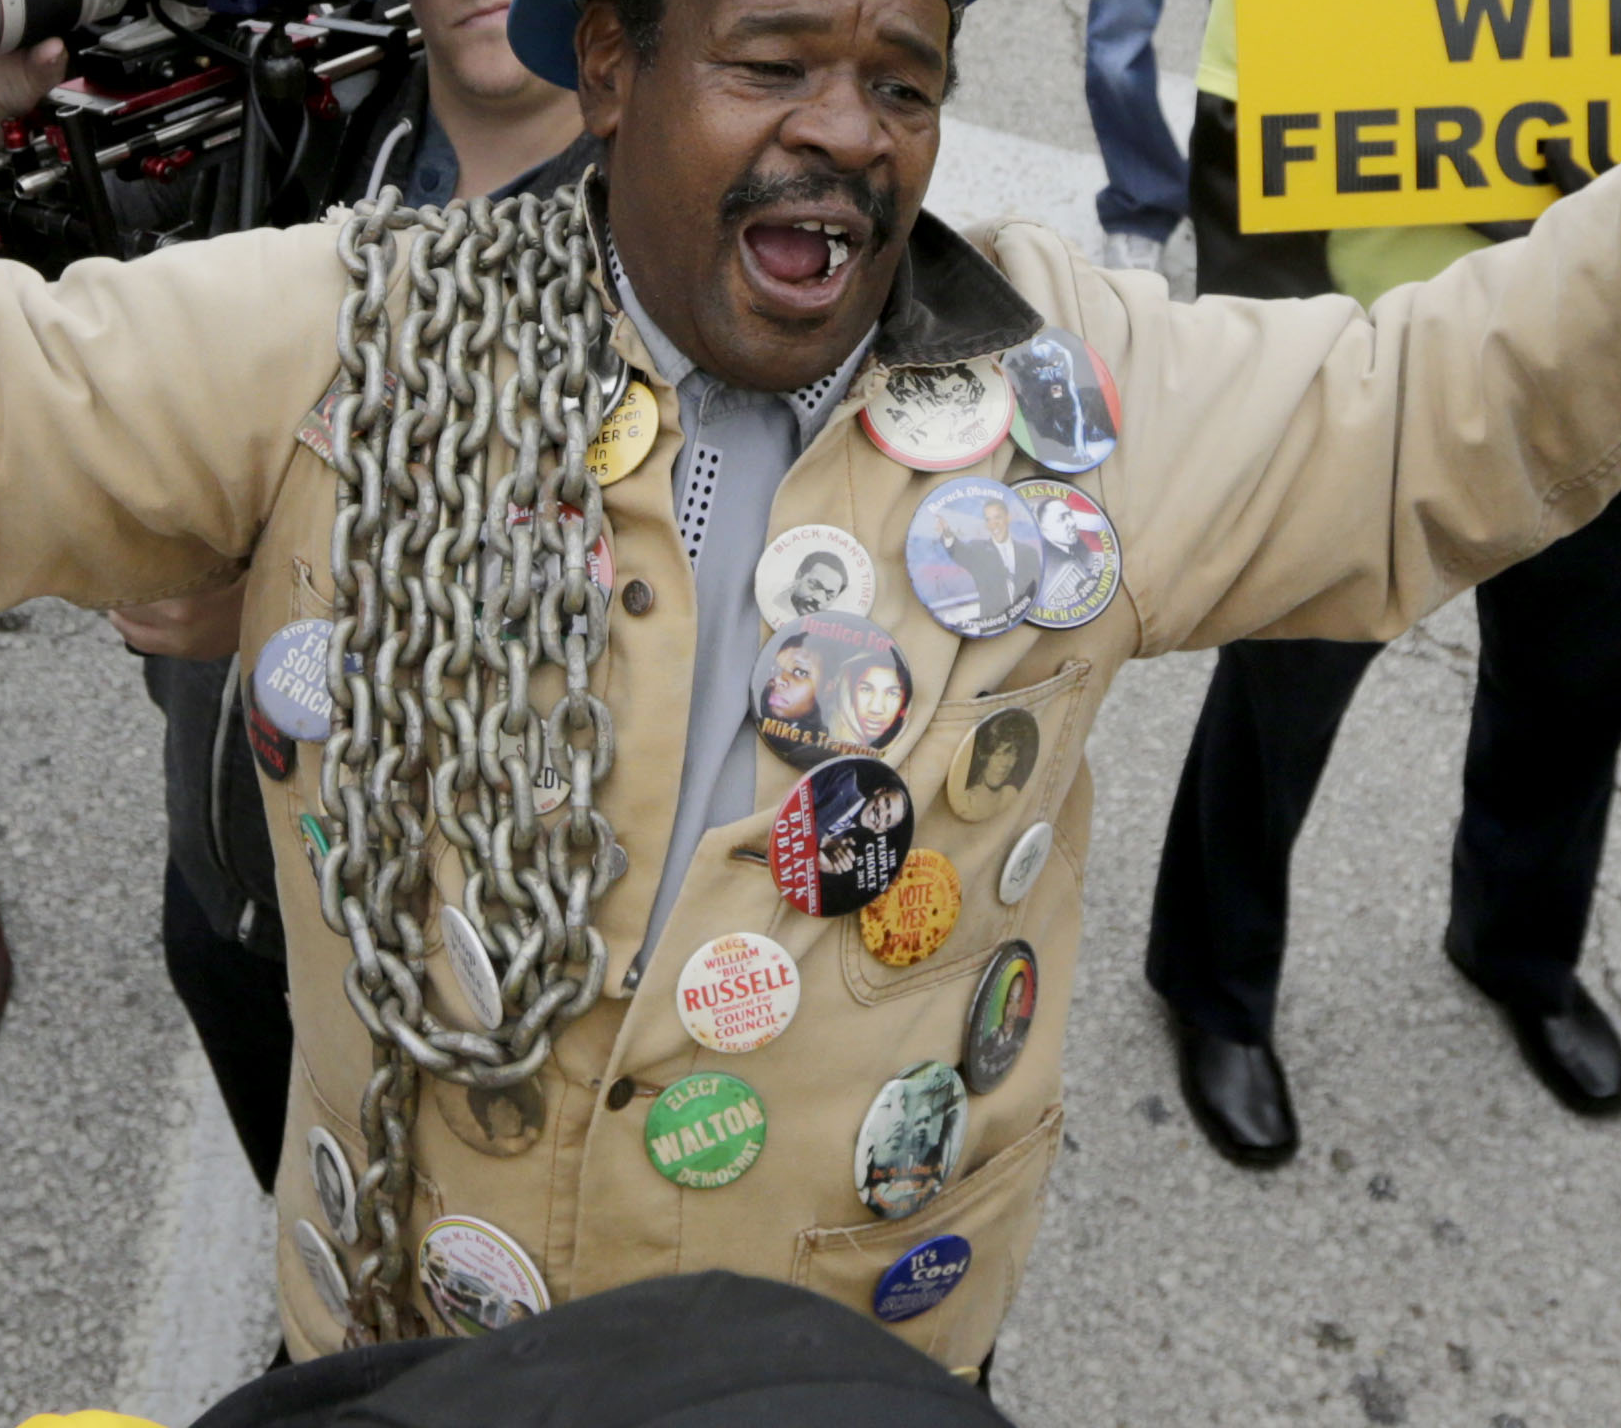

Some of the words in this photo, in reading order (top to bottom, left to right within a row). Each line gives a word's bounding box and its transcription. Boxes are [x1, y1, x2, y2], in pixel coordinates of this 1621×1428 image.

[928, 486, 965, 513] Barack
[966, 486, 1005, 500] Obama
[1019, 484, 1071, 500] ERSARY
[773, 529, 821, 555] BLACK
[828, 531, 867, 568] MAN'S
[858, 571, 874, 608] TIME
[961, 613, 1008, 629] President
[1008, 595, 1032, 619] 2008
[1034, 605, 1069, 622] ARCH
[1070, 604, 1089, 619] ON
[1049, 593, 1081, 609] August
[282, 622, 315, 641] STOP
[802, 615, 865, 647] Justice
[865, 631, 897, 652] For
[266, 666, 334, 720] AFRICA
[762, 717, 801, 743] Mike
[801, 731, 814, 744] &
[816, 730, 888, 759] Trayvon
[774, 818, 794, 898] OBAMA
[788, 810, 809, 901] BARACK
[857, 855, 865, 867] IN
[865, 842, 878, 892] CHOICE
[877, 835, 890, 894] PEOPLE'S
[889, 848, 898, 869] THE
[898, 883, 934, 908] VOTE
[899, 906, 929, 930] YES
[704, 947, 760, 970] WILLIAM
[712, 938, 749, 956] ELECT
[683, 963, 795, 1013] RUSSELL
[714, 1003, 773, 1028] COUNTY
[714, 1014, 779, 1040] COUNCIL
[665, 1077, 721, 1112] ELECT
[651, 1096, 764, 1167] WALTON
[676, 1139, 761, 1189] DEMOCRAT
[911, 1248, 938, 1272] It's
[912, 1257, 968, 1283] cool
